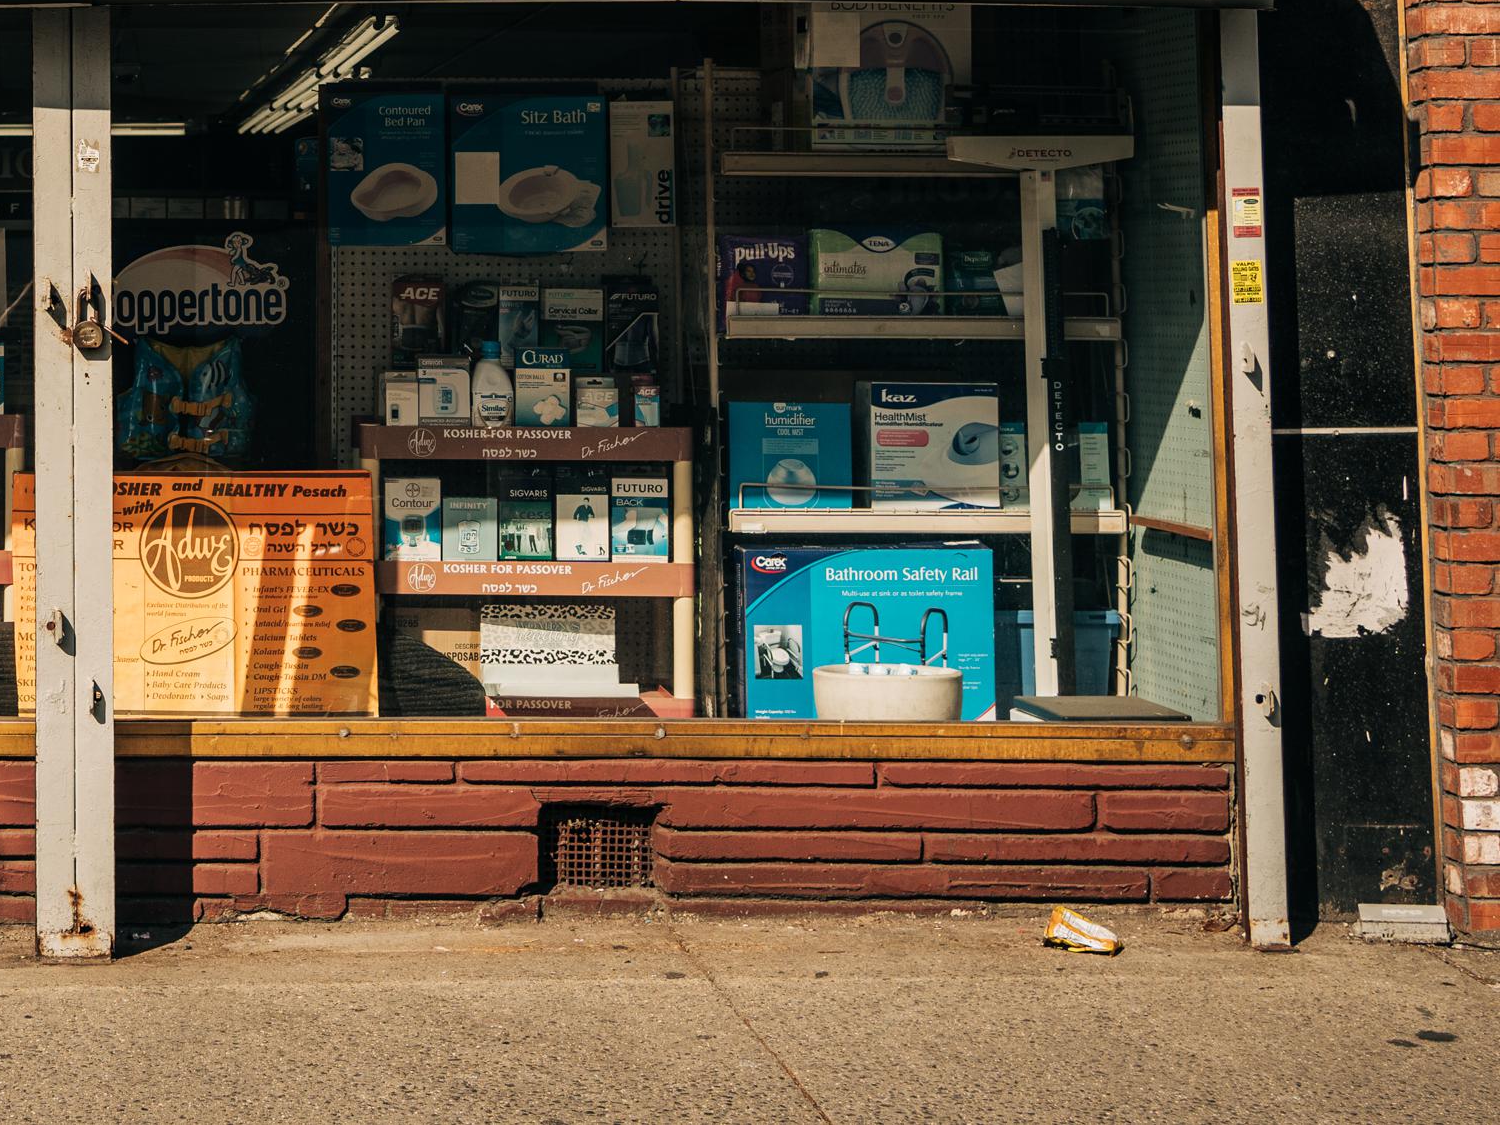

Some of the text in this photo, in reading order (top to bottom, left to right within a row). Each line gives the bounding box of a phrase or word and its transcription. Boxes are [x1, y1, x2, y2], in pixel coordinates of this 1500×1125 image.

[379, 105, 431, 116] Contoured
[385, 117, 403, 127] Bed
[521, 109, 587, 124] Sitz Bath
[1017, 149, 1072, 158] DETECTO
[655, 169, 670, 224] drive
[869, 240, 890, 248] TENA
[823, 261, 867, 275] intimates
[400, 287, 440, 300] ACE
[502, 290, 537, 298] FUTURO
[113, 282, 283, 333] oppertone
[522, 350, 563, 365] CURAD
[581, 391, 614, 402] ACE
[881, 389, 917, 403] kaz
[765, 413, 815, 425] humidifier
[875, 412, 927, 422] HealthMist
[1053, 381, 1065, 452] DETECTO
[444, 428, 571, 440] KOSHER FOR PASSOVER
[482, 447, 537, 458] כשר לפסח
[172, 479, 203, 492] and
[212, 483, 289, 497] HEALTHY
[292, 485, 347, 497] Pesach
[509, 489, 548, 497] SIGVARIS
[616, 484, 663, 493] FUTURO
[392, 498, 434, 508] Contour
[616, 498, 643, 506] BACK
[249, 520, 360, 537] כשר לפסח
[267, 542, 306, 553] השנה
[755, 556, 787, 567] Carex
[243, 567, 365, 576] PHARMACEUTICALS
[443, 564, 572, 575] KOSHER FOR PASSOVER
[825, 567, 978, 584] Bathroom Safety Rail
[482, 582, 537, 593] כשר לפסח
[170, 621, 224, 648] Fischer
[179, 640, 213, 656] כשר לפסח
[175, 670, 200, 678] Cream
[152, 681, 227, 690] Baby Care Products
[152, 692, 230, 701] Deodorants Soaps
[490, 699, 572, 710] FOR PASSOVER
